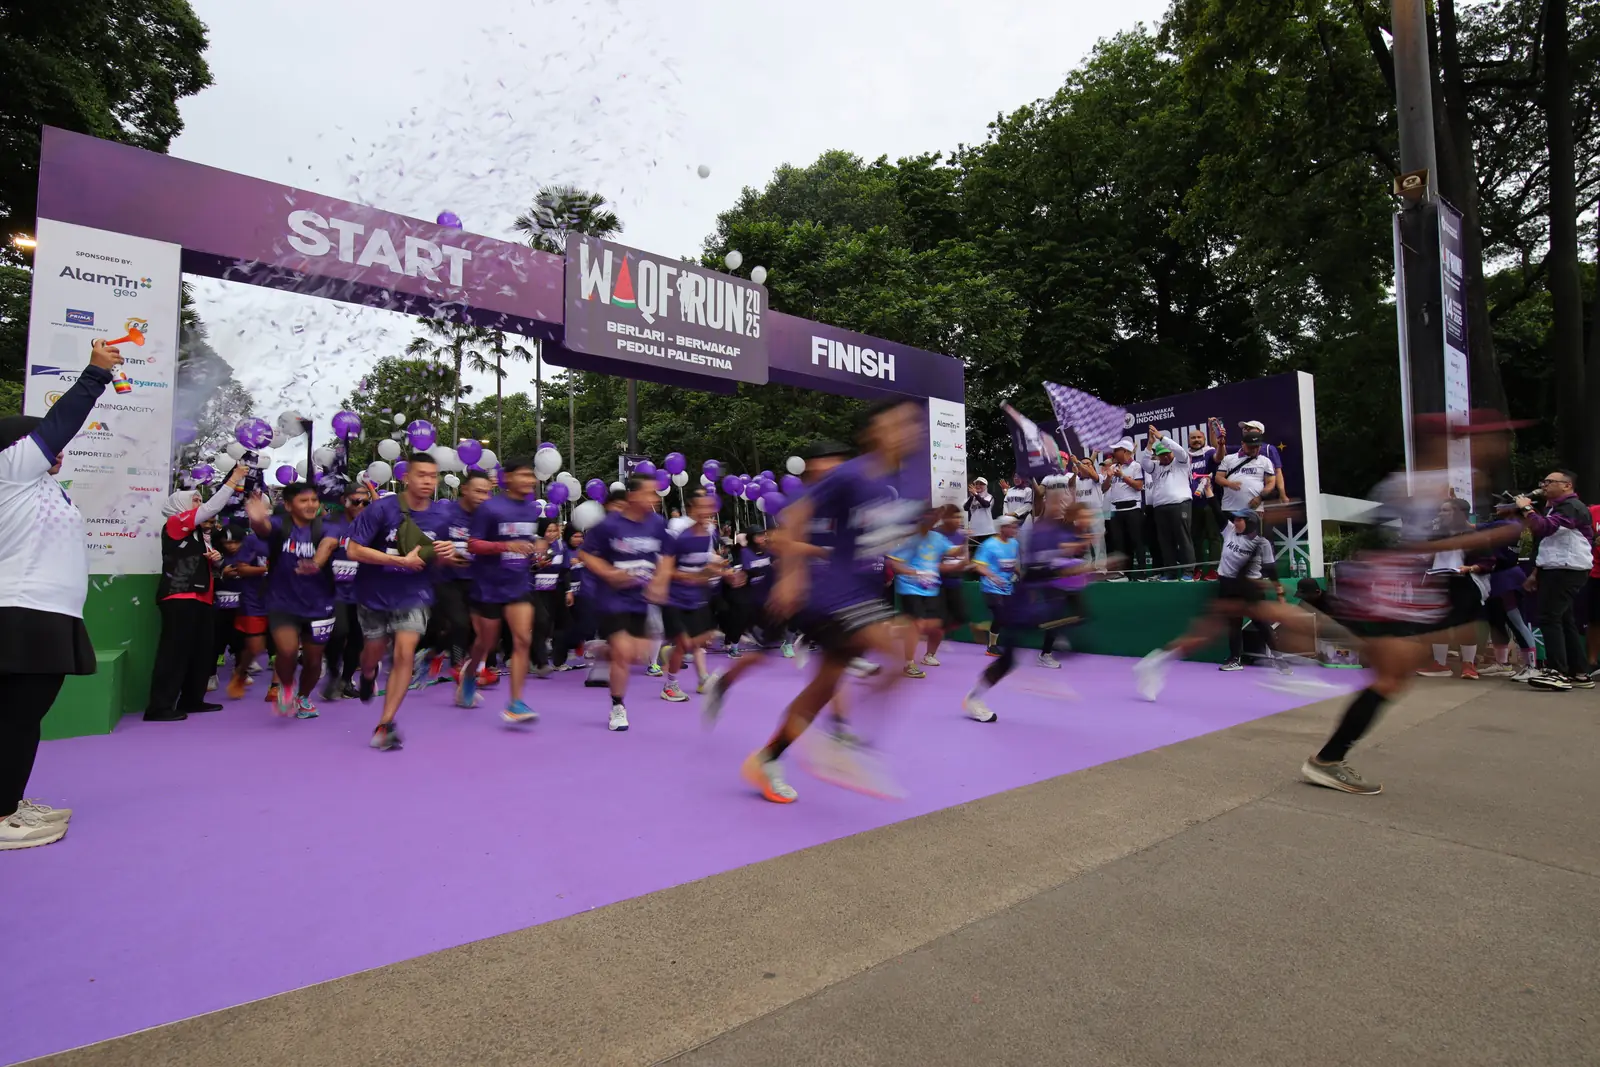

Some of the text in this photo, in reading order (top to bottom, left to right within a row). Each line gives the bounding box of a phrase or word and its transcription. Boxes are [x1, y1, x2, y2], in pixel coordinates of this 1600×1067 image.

[287, 209, 471, 287] START
[75, 250, 133, 266] SPONSORED BY:
[59, 265, 138, 290] AlamTri
[113, 287, 138, 298] geo
[685, 272, 745, 336] RUN
[69, 313, 91, 321] PRIMA
[606, 320, 665, 342] BERLARI
[676, 335, 741, 357] BERWAKAF
[617, 338, 733, 371] PEDULI PALESTINA
[811, 335, 896, 382] FINISH
[59, 374, 79, 383] AST
[94, 402, 155, 414] UNINGANCITY
[1135, 410, 1155, 418] BADAN
[1136, 411, 1176, 424] INDONESIA
[68, 449, 112, 458] SUPPORTED
